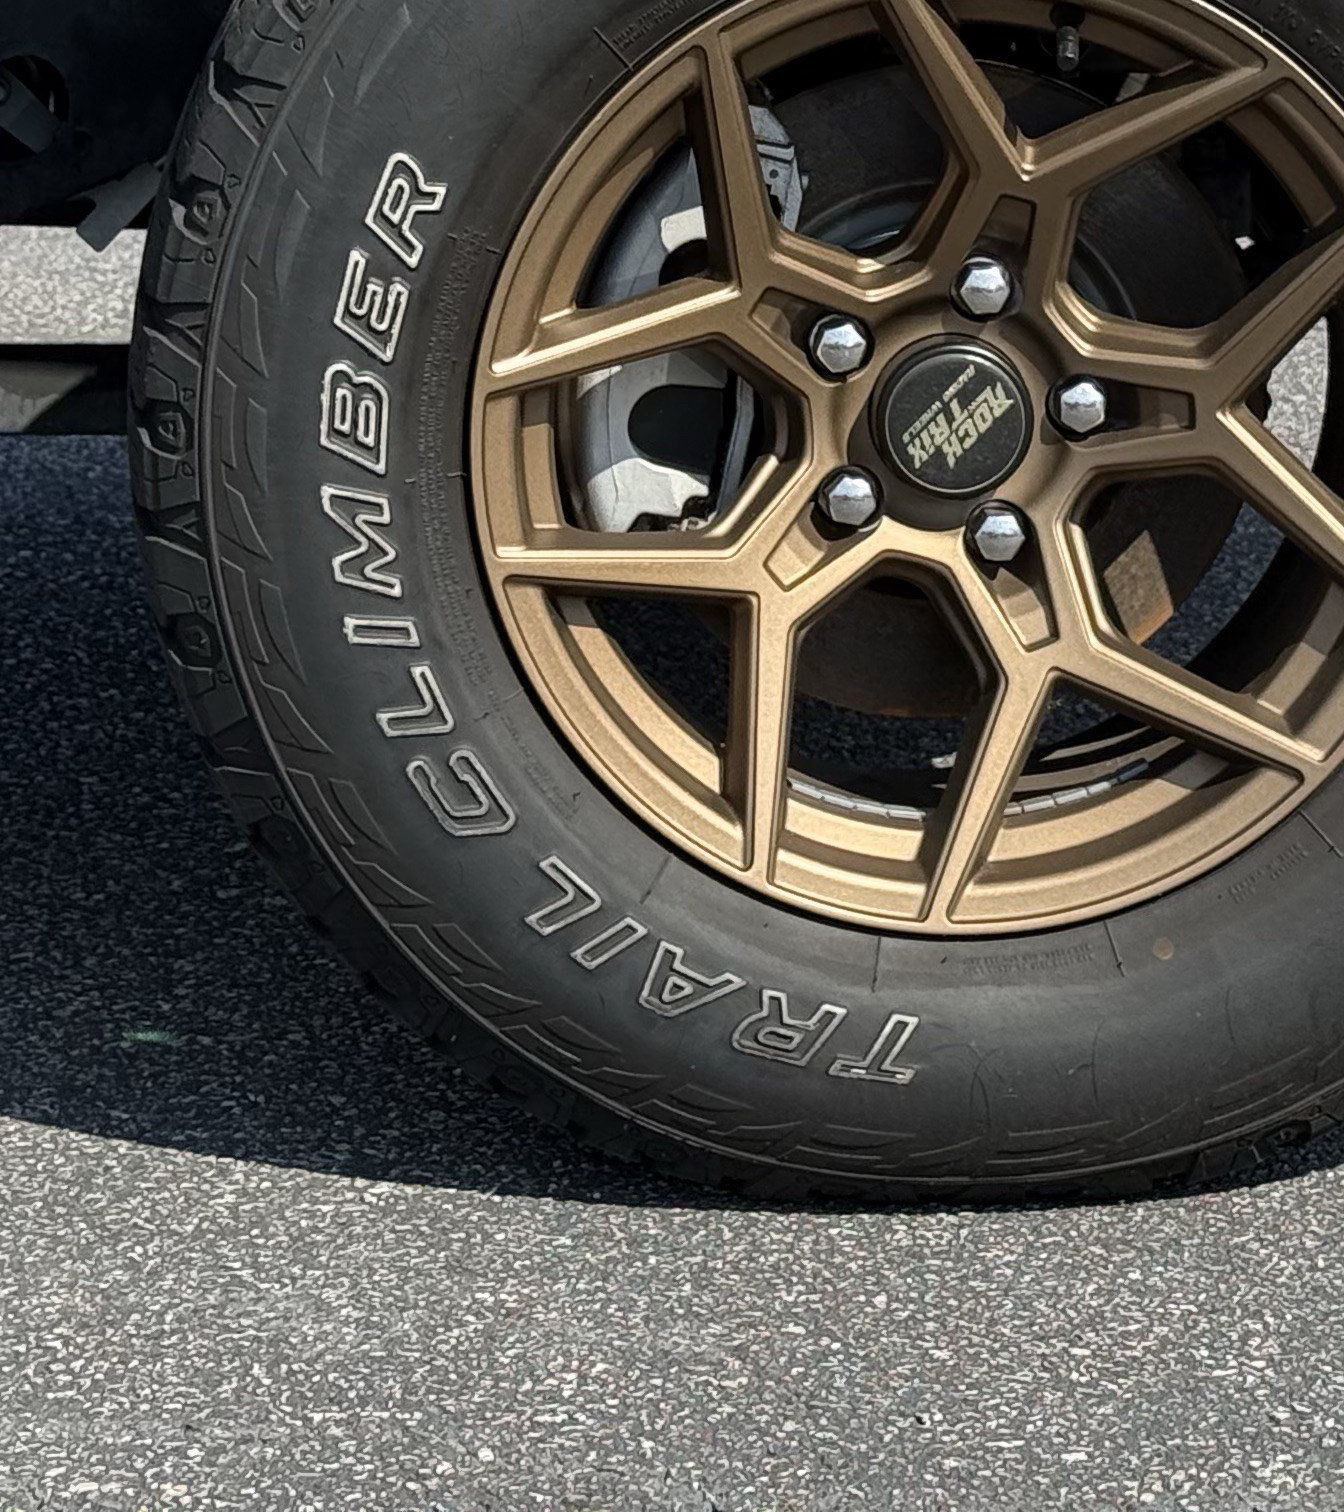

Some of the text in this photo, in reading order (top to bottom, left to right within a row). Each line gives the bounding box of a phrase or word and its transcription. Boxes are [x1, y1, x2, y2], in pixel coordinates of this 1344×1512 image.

[318, 150, 920, 1086] TRAIL CLIMBER
[941, 381, 1014, 469] ROCK
